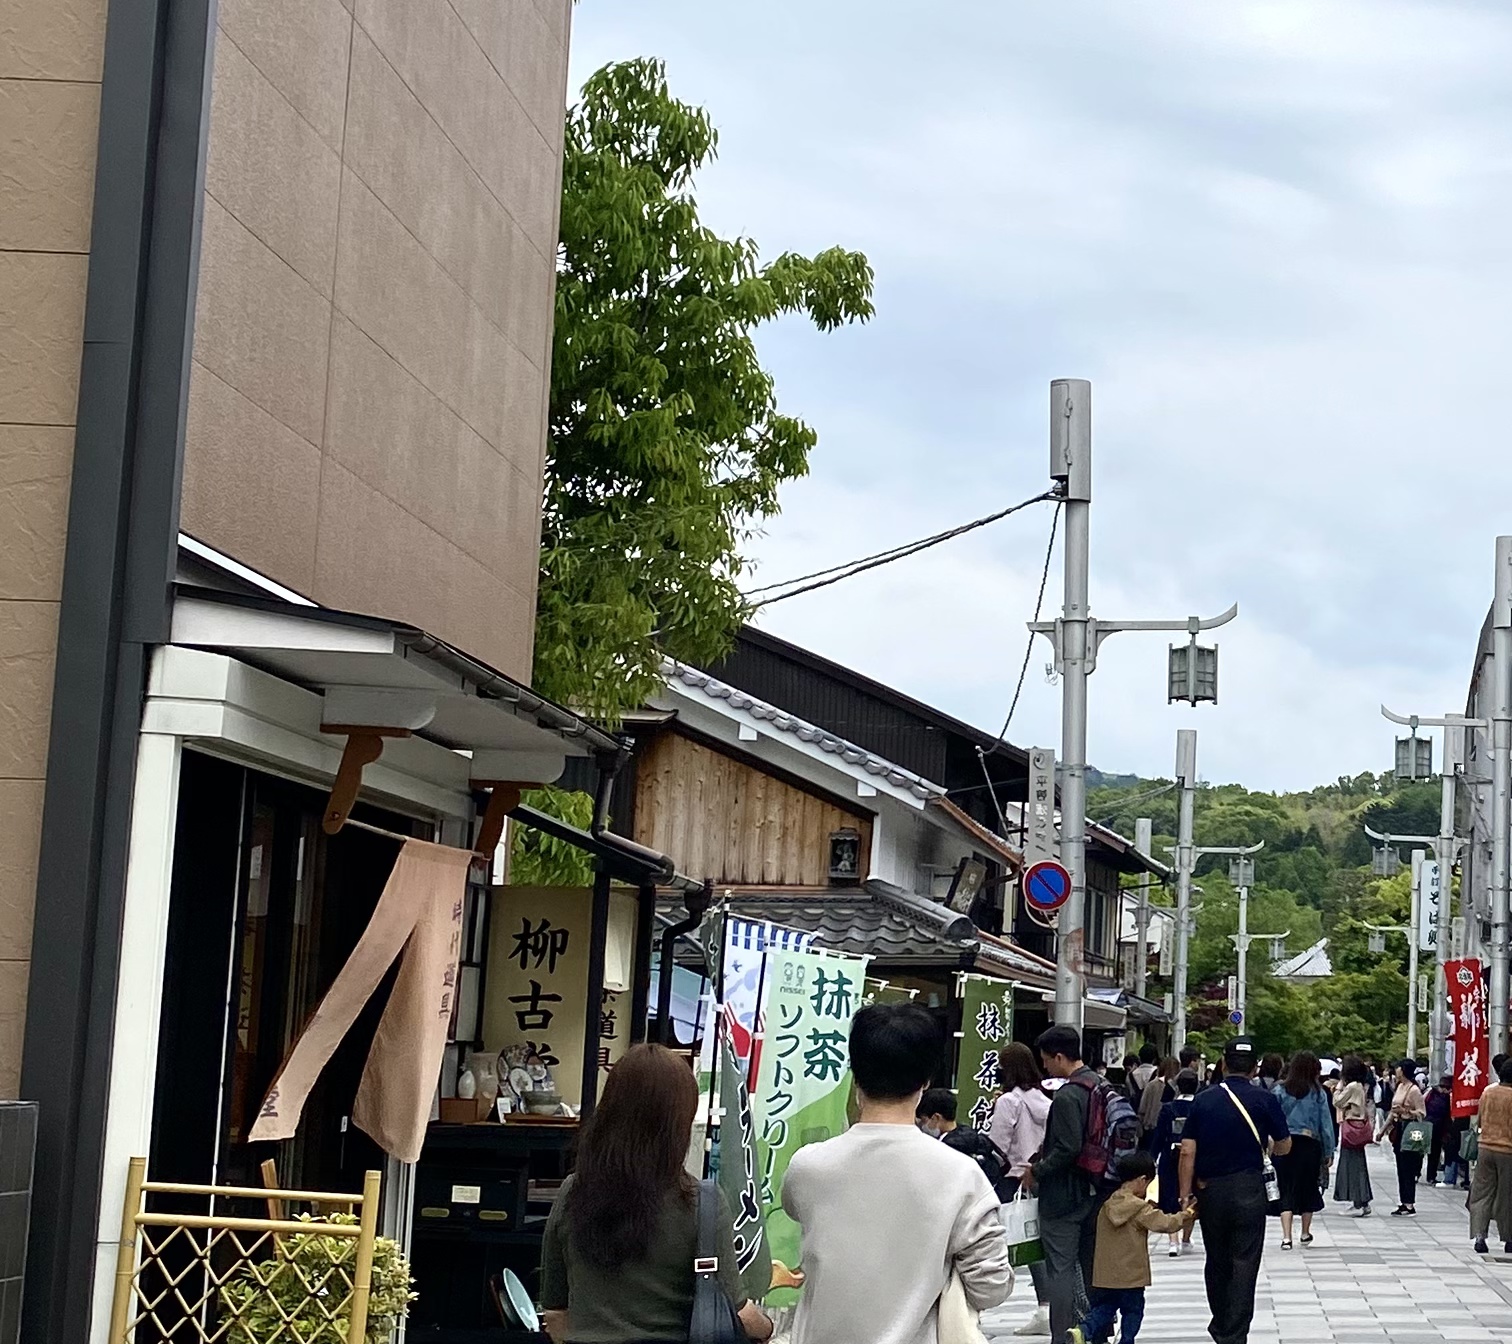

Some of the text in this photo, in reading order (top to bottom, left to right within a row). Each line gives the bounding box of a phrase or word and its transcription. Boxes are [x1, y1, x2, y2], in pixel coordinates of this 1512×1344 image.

[804, 966, 853, 1082] 抹茶
[760, 1003, 803, 1204] ソフトクリーム
